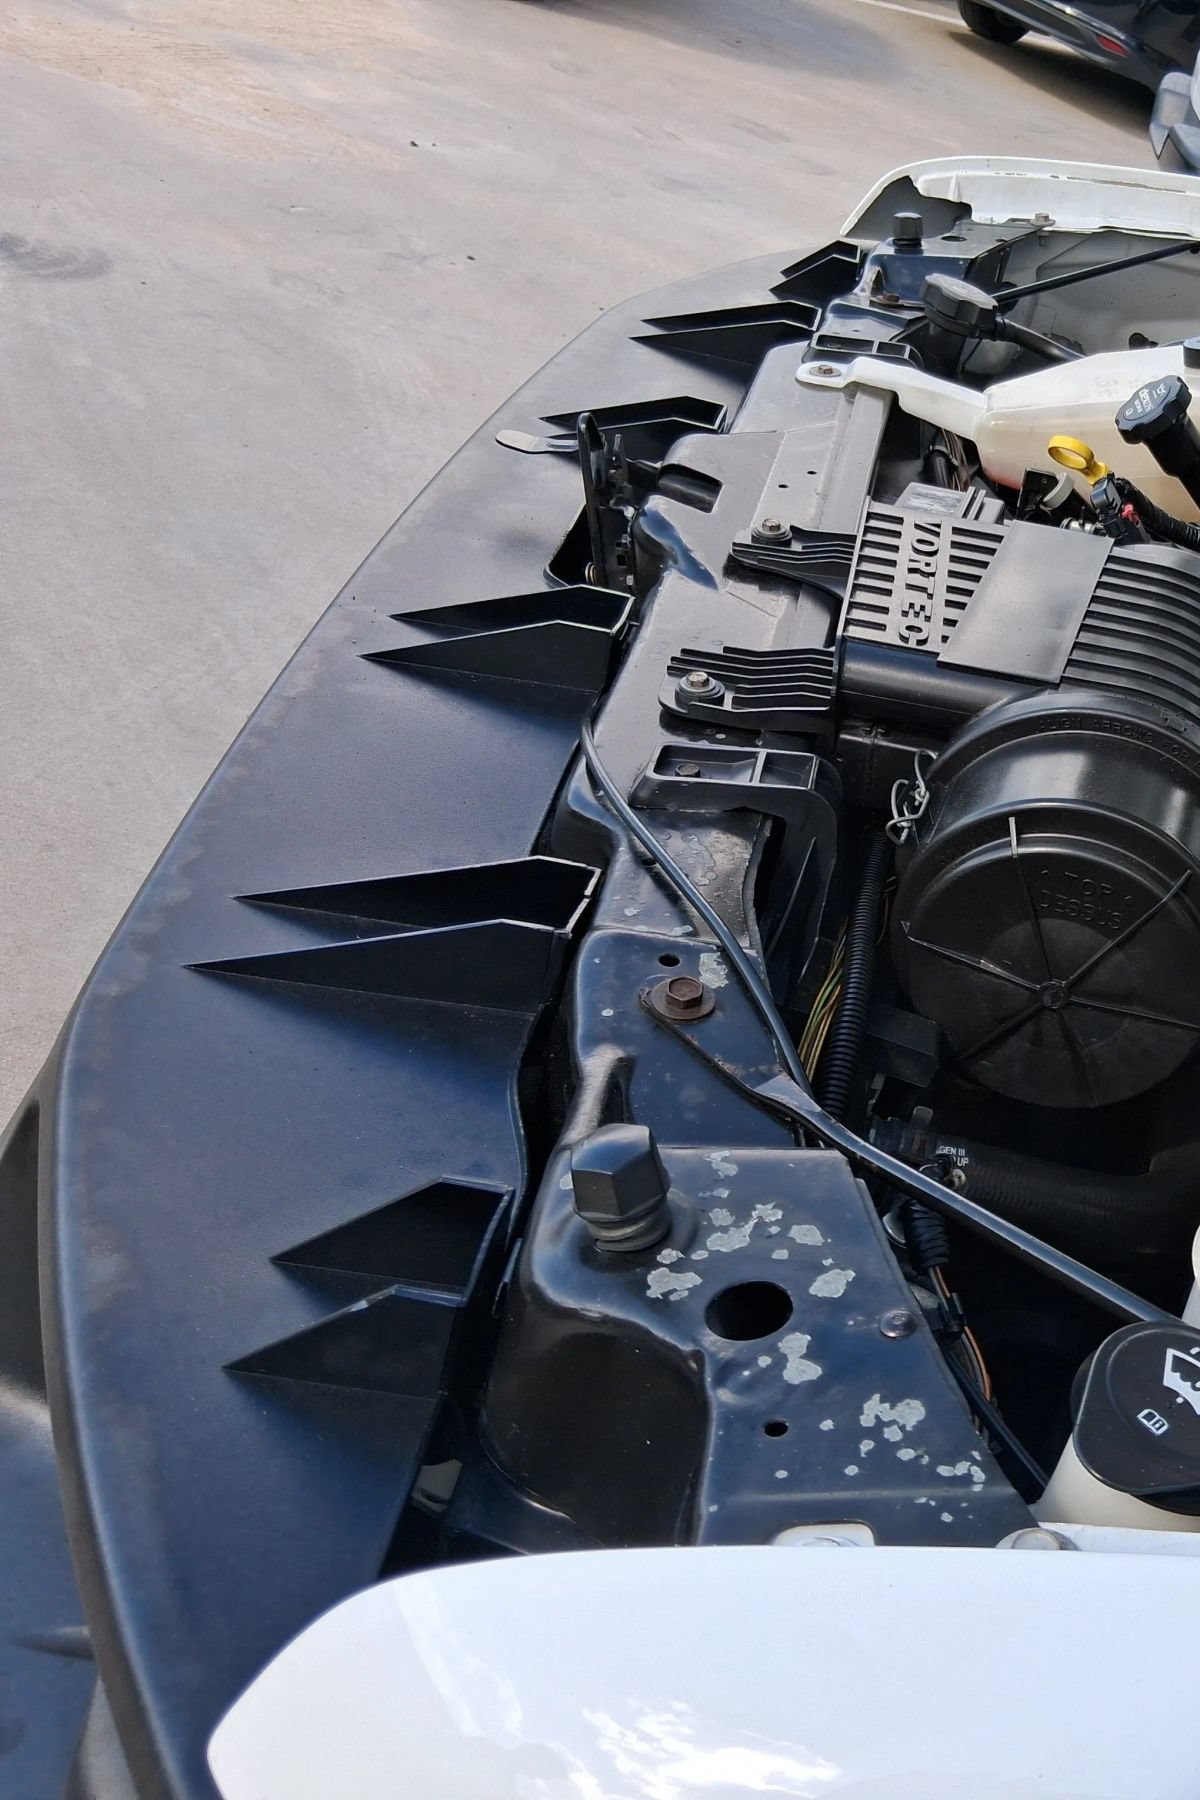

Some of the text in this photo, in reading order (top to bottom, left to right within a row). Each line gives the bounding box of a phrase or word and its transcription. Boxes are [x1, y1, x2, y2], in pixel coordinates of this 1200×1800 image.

[898, 520, 942, 646] VORTEC
[1039, 717, 1081, 731] ALIGN
[1091, 717, 1155, 743] ARROWS
[1161, 740, 1190, 762] FOR
[1064, 871, 1114, 899] TOP
[1039, 889, 1123, 929] DESSUS
[939, 1146, 956, 1155] GEN
